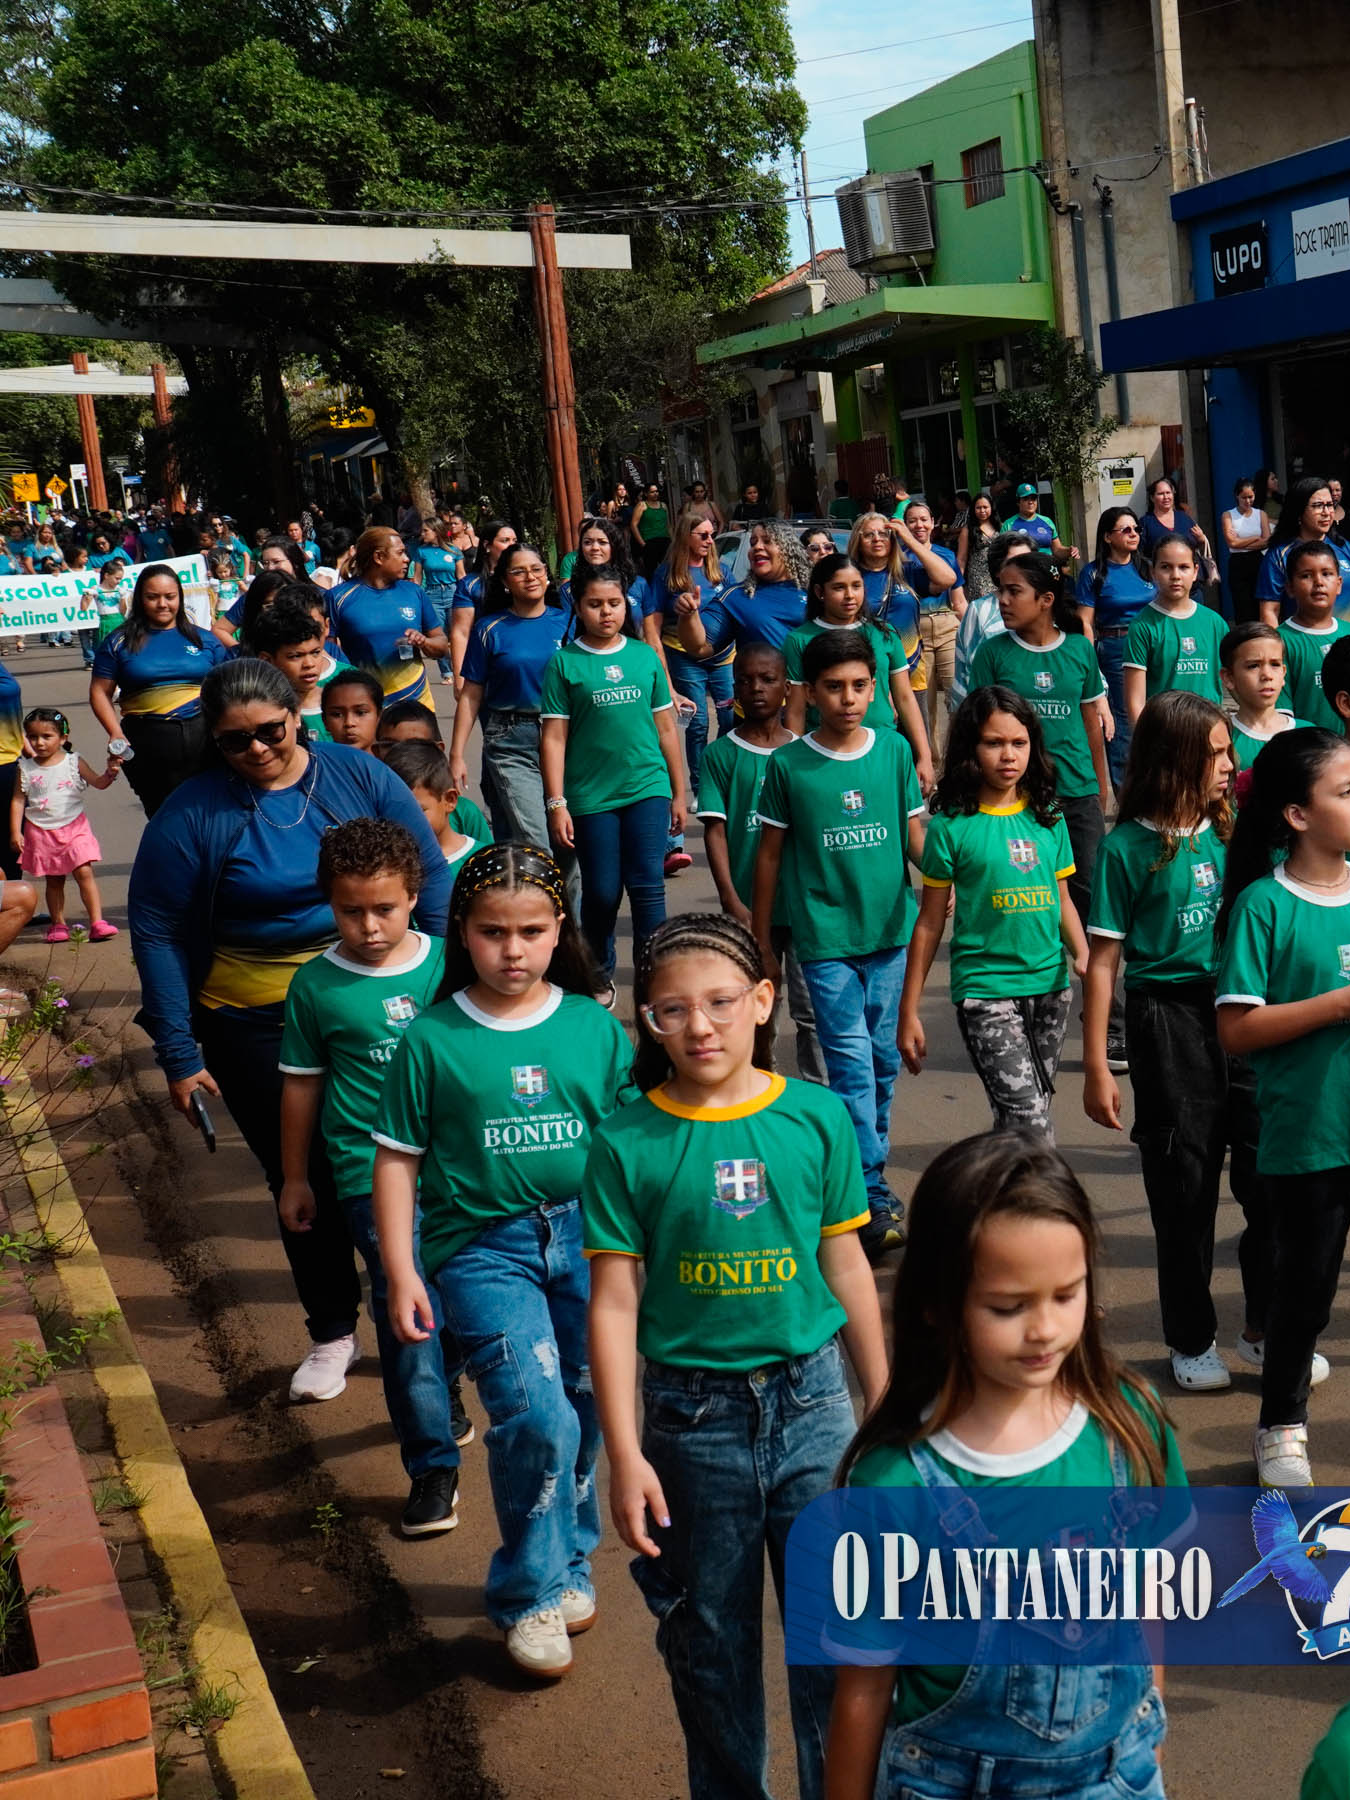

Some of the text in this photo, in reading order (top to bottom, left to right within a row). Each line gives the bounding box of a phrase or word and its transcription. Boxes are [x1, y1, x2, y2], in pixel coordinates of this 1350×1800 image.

[1294, 220, 1350, 256] DOCE TRAMA
[1213, 241, 1262, 284] LUPO
[592, 689, 641, 704] BONITO
[1030, 703, 1071, 715] NITO
[822, 827, 887, 847] BONITO
[486, 1116, 528, 1125] PREFEITURA
[529, 1113, 563, 1121] MUNICIPAL
[482, 1119, 583, 1148] BONITO
[493, 1147, 514, 1155] MATO
[516, 1144, 548, 1153] GROSSO
[562, 1141, 574, 1149] SUL
[679, 1257, 797, 1285] BONITO
[753, 1286, 766, 1294] DO
